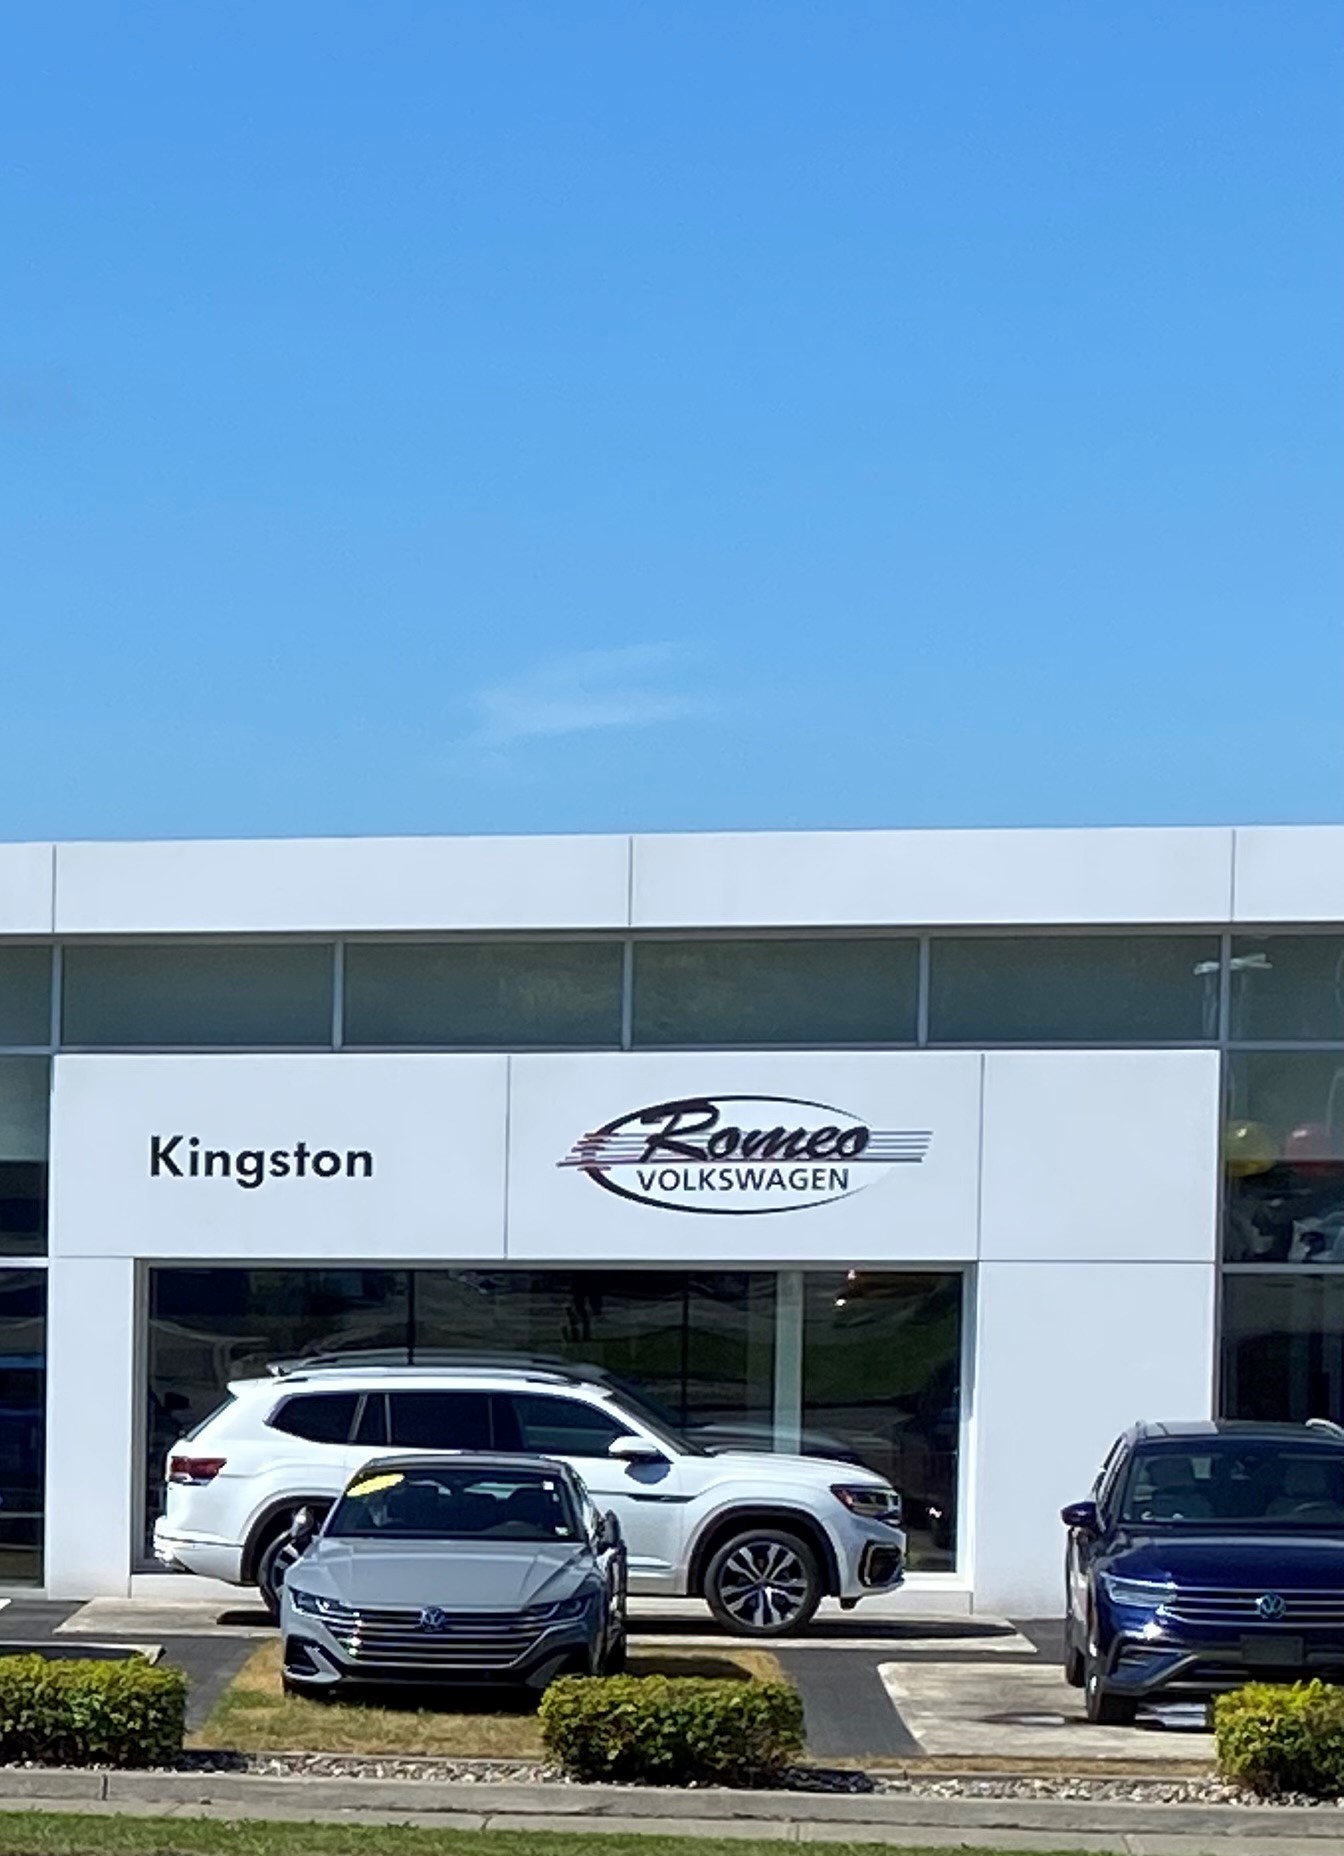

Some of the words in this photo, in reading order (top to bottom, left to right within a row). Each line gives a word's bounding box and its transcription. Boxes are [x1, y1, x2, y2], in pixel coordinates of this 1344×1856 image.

[640, 1100, 870, 1162] Romeo
[150, 1134, 374, 1189] Kingston
[636, 1168, 850, 1191] VOLKSWAGEN
